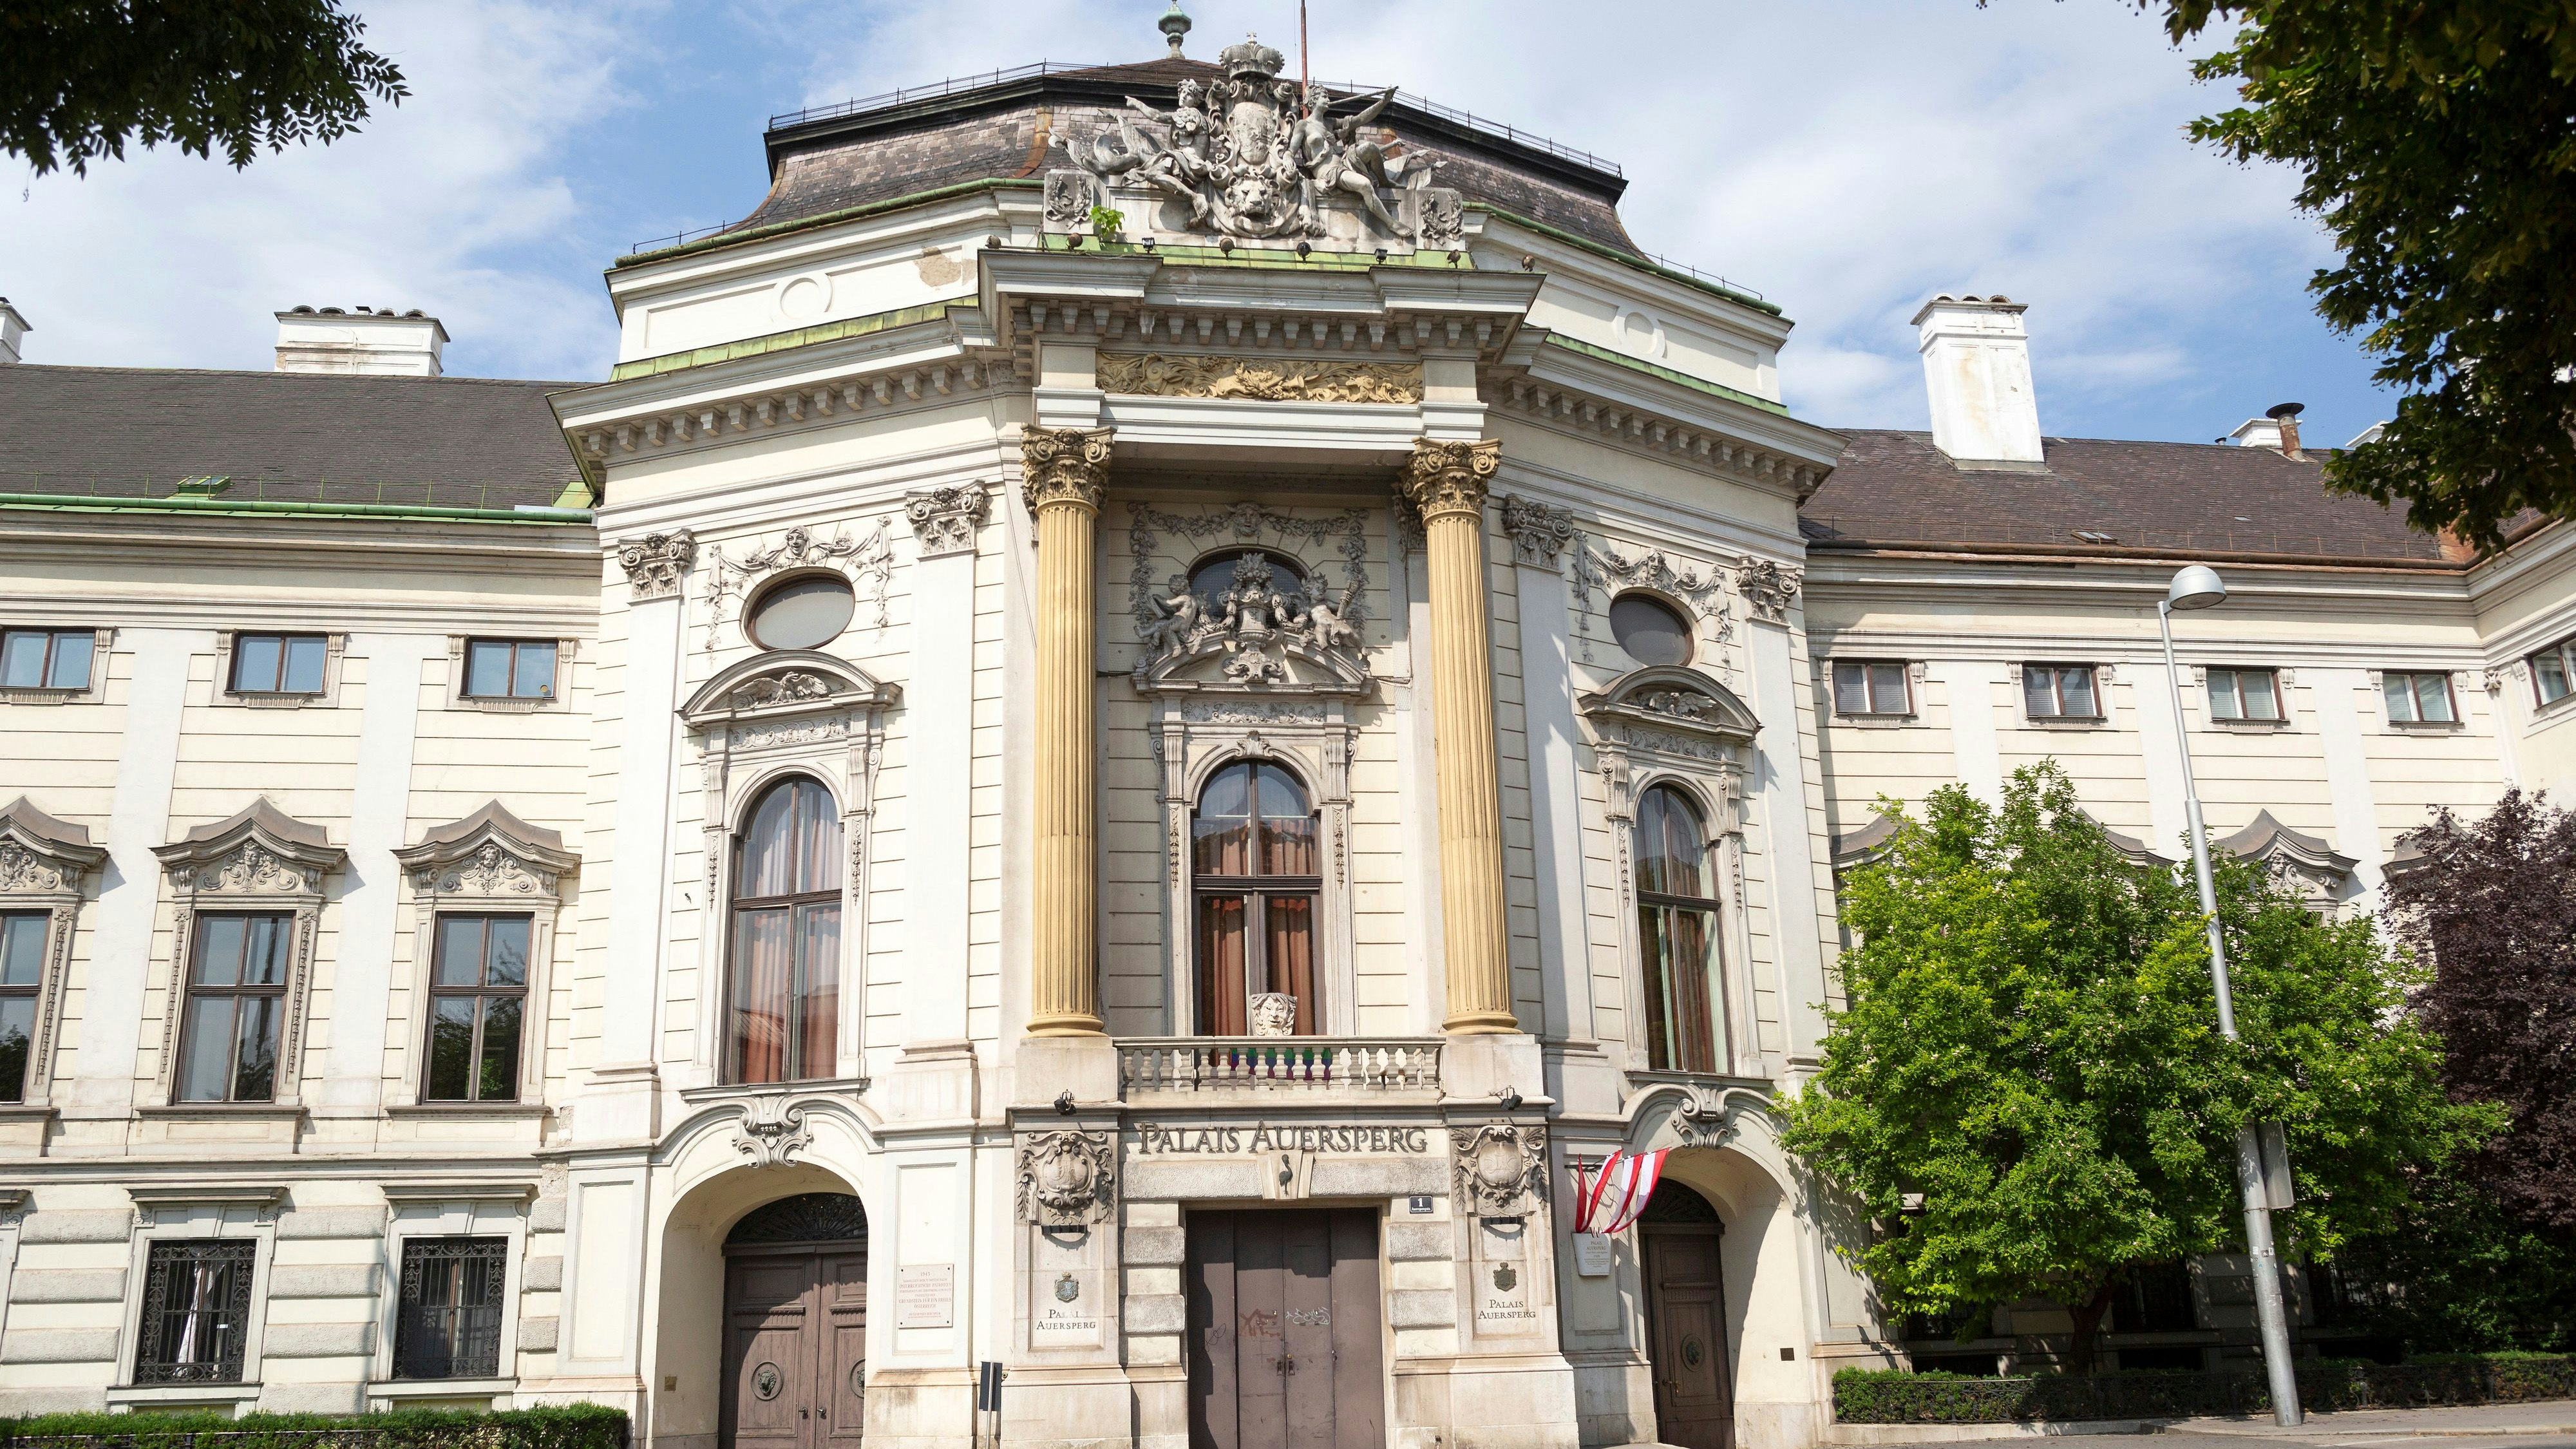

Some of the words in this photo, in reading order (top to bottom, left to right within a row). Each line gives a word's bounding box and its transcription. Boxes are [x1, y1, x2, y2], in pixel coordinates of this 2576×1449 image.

[1135, 1121, 1240, 1155] PALAIS
[1248, 1119, 1428, 1154] AUERSPERG
[1417, 1198, 1423, 1208] 1
[1489, 1299, 1524, 1309] PALAIS
[1477, 1310, 1536, 1320] AUERSPERG
[1036, 1321, 1096, 1330] AUERSPERG
